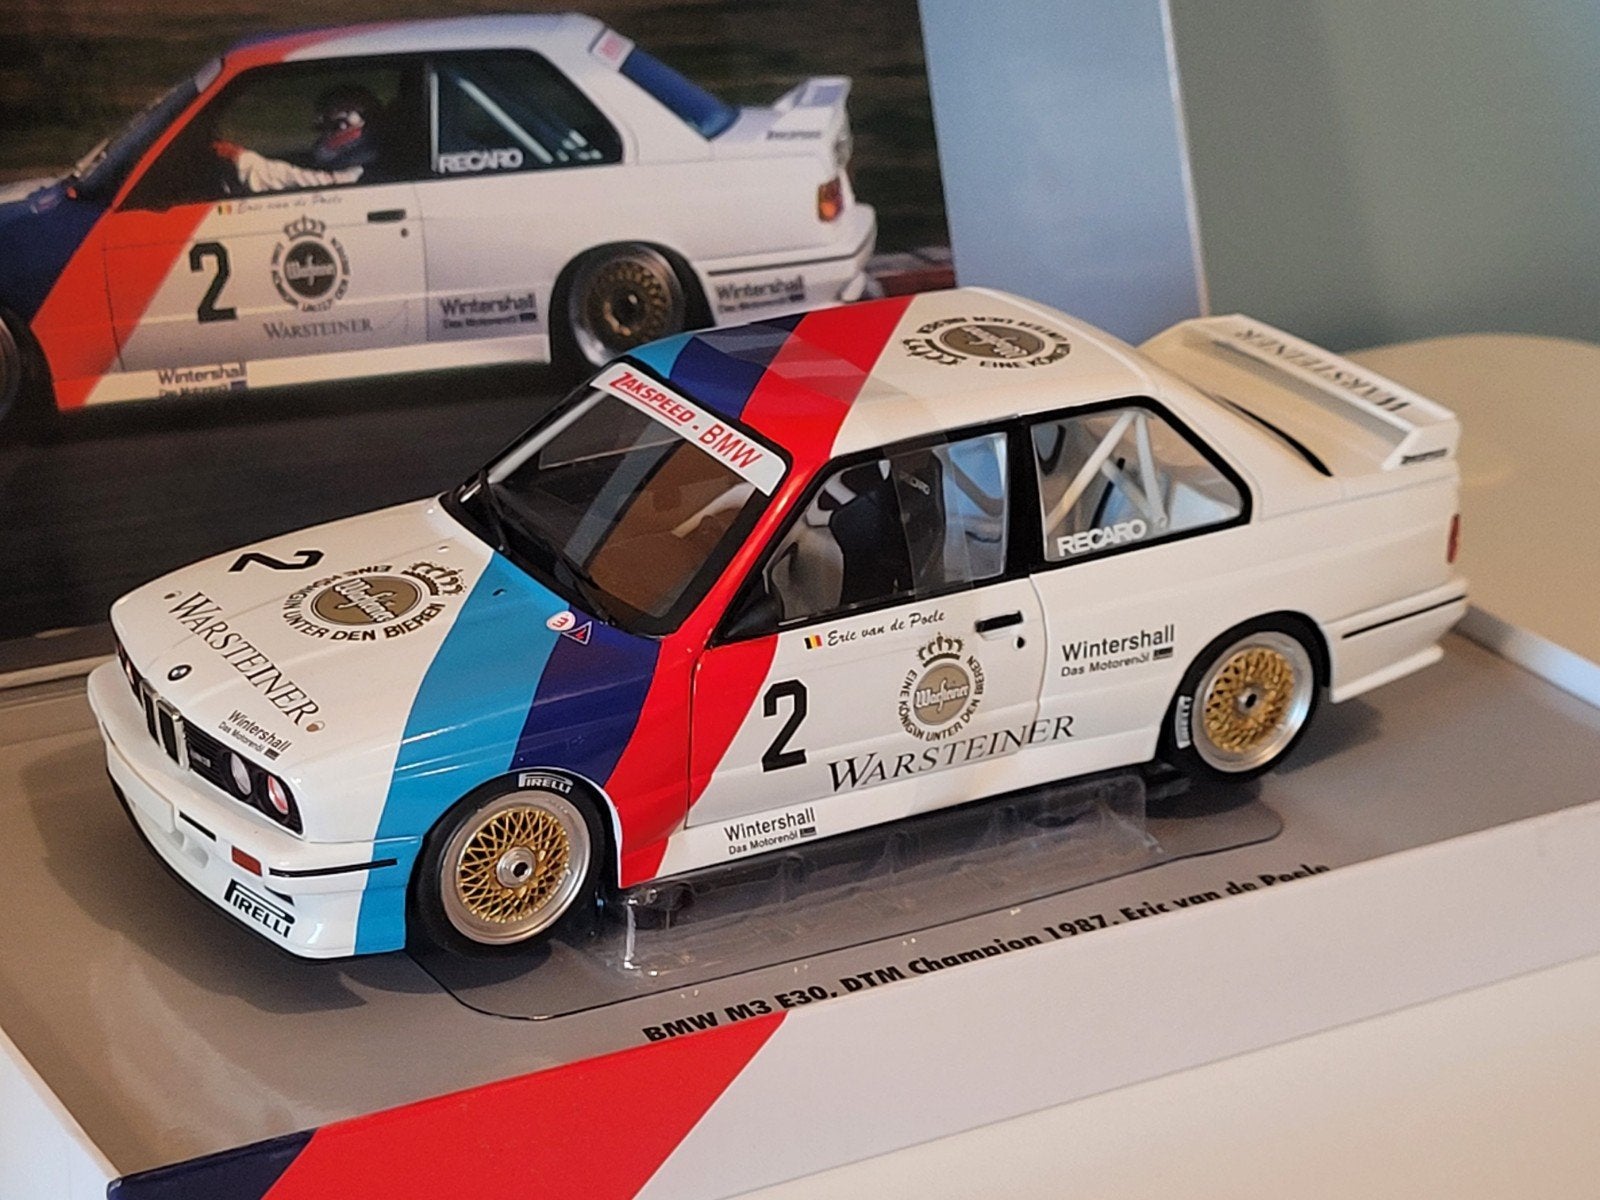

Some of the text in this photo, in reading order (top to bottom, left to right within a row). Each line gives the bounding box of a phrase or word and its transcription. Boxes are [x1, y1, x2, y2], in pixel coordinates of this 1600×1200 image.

[438, 148, 523, 174] RECARO
[189, 241, 237, 323] 2
[263, 319, 373, 339] WARSTEINER
[609, 371, 763, 468] ZAKSPEED BMW
[1057, 519, 1147, 557] RECARO
[228, 550, 323, 573] 2
[282, 611, 330, 639] UNTER
[330, 629, 376, 642] DEN
[383, 602, 446, 639] BIEREN
[827, 609, 945, 647] Eric van de Poele
[168, 591, 320, 727] WARSTEINER
[1062, 623, 1175, 662] Wintershall
[900, 669, 918, 697] EINE
[966, 655, 985, 695] BIEREN
[1061, 664, 1085, 678] Das
[762, 678, 808, 773] 2
[960, 698, 981, 724] DEN
[228, 709, 292, 752] Wintershall
[926, 721, 964, 742] UNTER
[828, 714, 1076, 793] WARSTEINER
[518, 771, 574, 795] PIRELLI
[724, 806, 816, 842] Wintershall
[728, 830, 798, 856] Das Motorenöl
[224, 878, 296, 939] PIRELLI
[642, 1011, 719, 1042] BMW
[724, 999, 772, 1021] M3
[839, 966, 906, 993] DTM
[908, 935, 1042, 975] Champion
[1120, 901, 1170, 921] Eric
[1173, 890, 1221, 909] van
